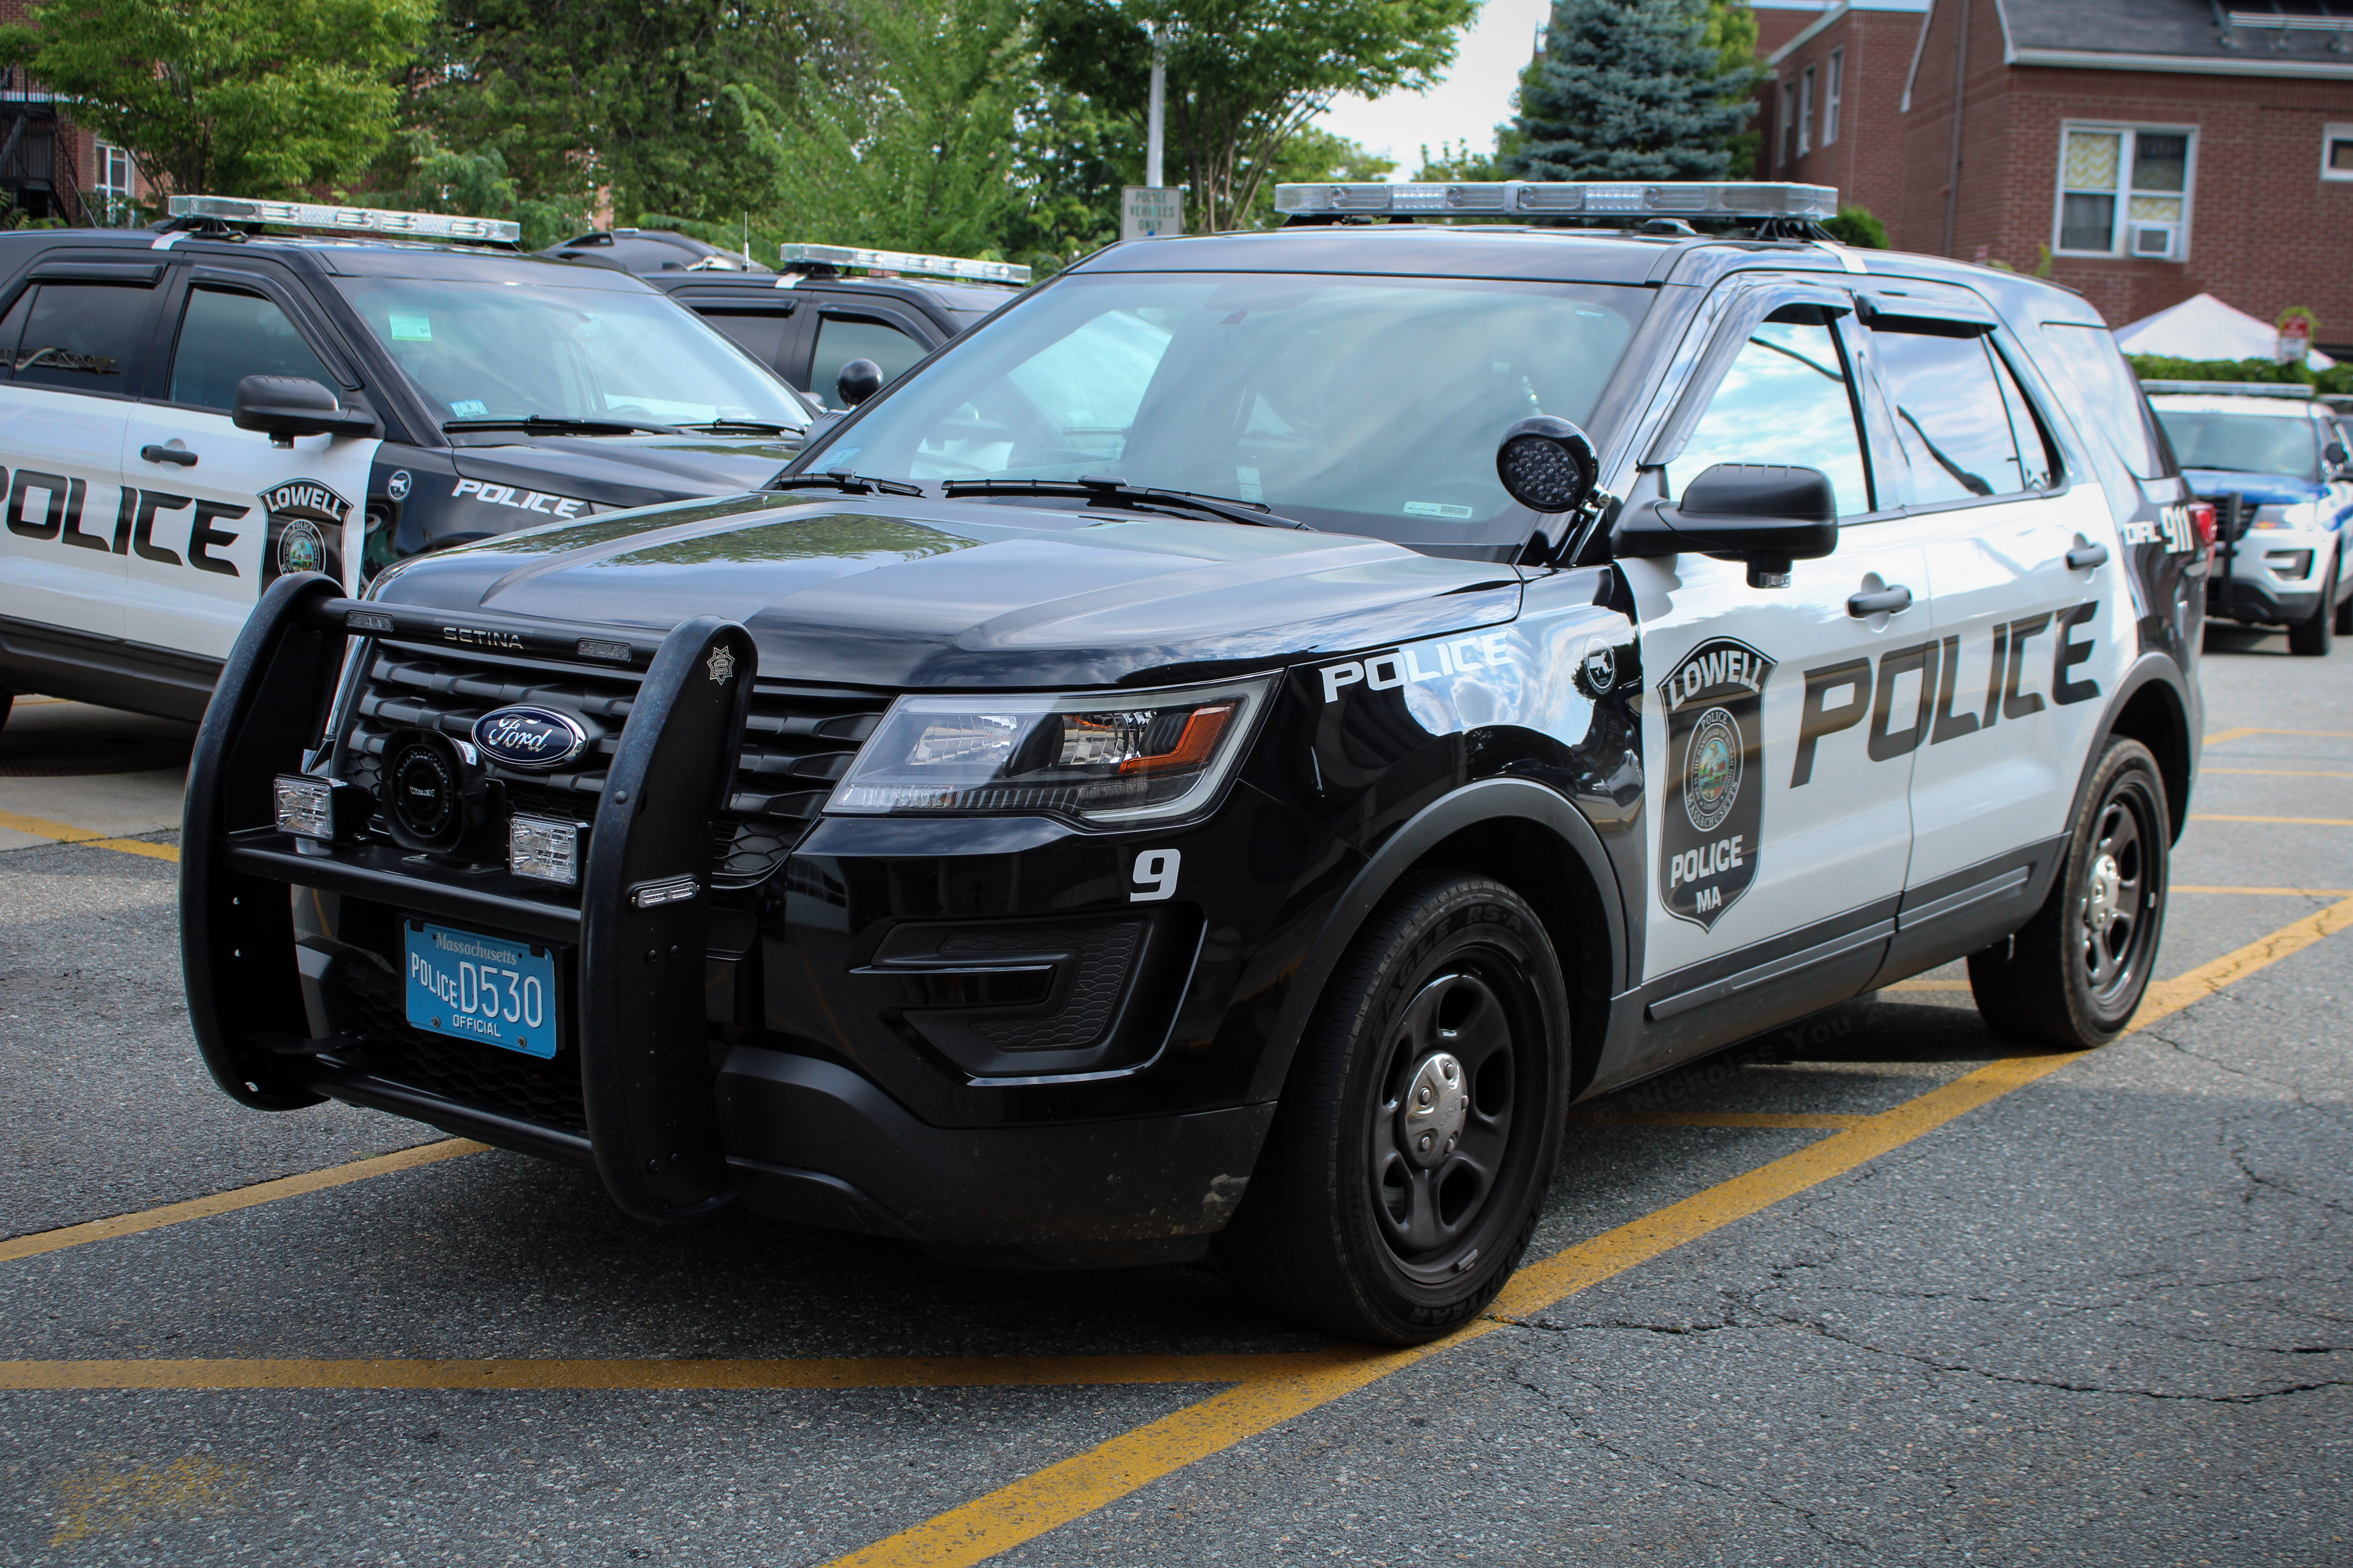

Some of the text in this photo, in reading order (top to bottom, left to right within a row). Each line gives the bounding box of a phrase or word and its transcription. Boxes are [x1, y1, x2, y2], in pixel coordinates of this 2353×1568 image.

[1129, 204, 1175, 217] VEHICLES
[1135, 191, 1167, 203] POLICE
[1139, 219, 1163, 231] ONLY
[265, 485, 342, 522] LOWELL
[452, 478, 587, 519] POLICE
[0, 465, 251, 577] OLICE
[292, 522, 314, 532] POLICE
[2159, 505, 2194, 554] 911
[443, 626, 524, 650] SETINA
[1318, 631, 1514, 704] POLICE
[1668, 650, 1762, 712] LOWELL
[1789, 600, 2102, 789] POLICE
[488, 713, 553, 752] Ford
[1701, 712, 1729, 730] POLICE
[1687, 781, 1738, 828] MASSACHUSETTS
[1129, 848, 1181, 902] 9
[1670, 835, 1743, 889] POLICE
[1695, 886, 1722, 914] MA
[435, 932, 517, 965] Massachusetts
[411, 951, 542, 1029] POLICE D530
[452, 1013, 502, 1038] OFFICIAL
